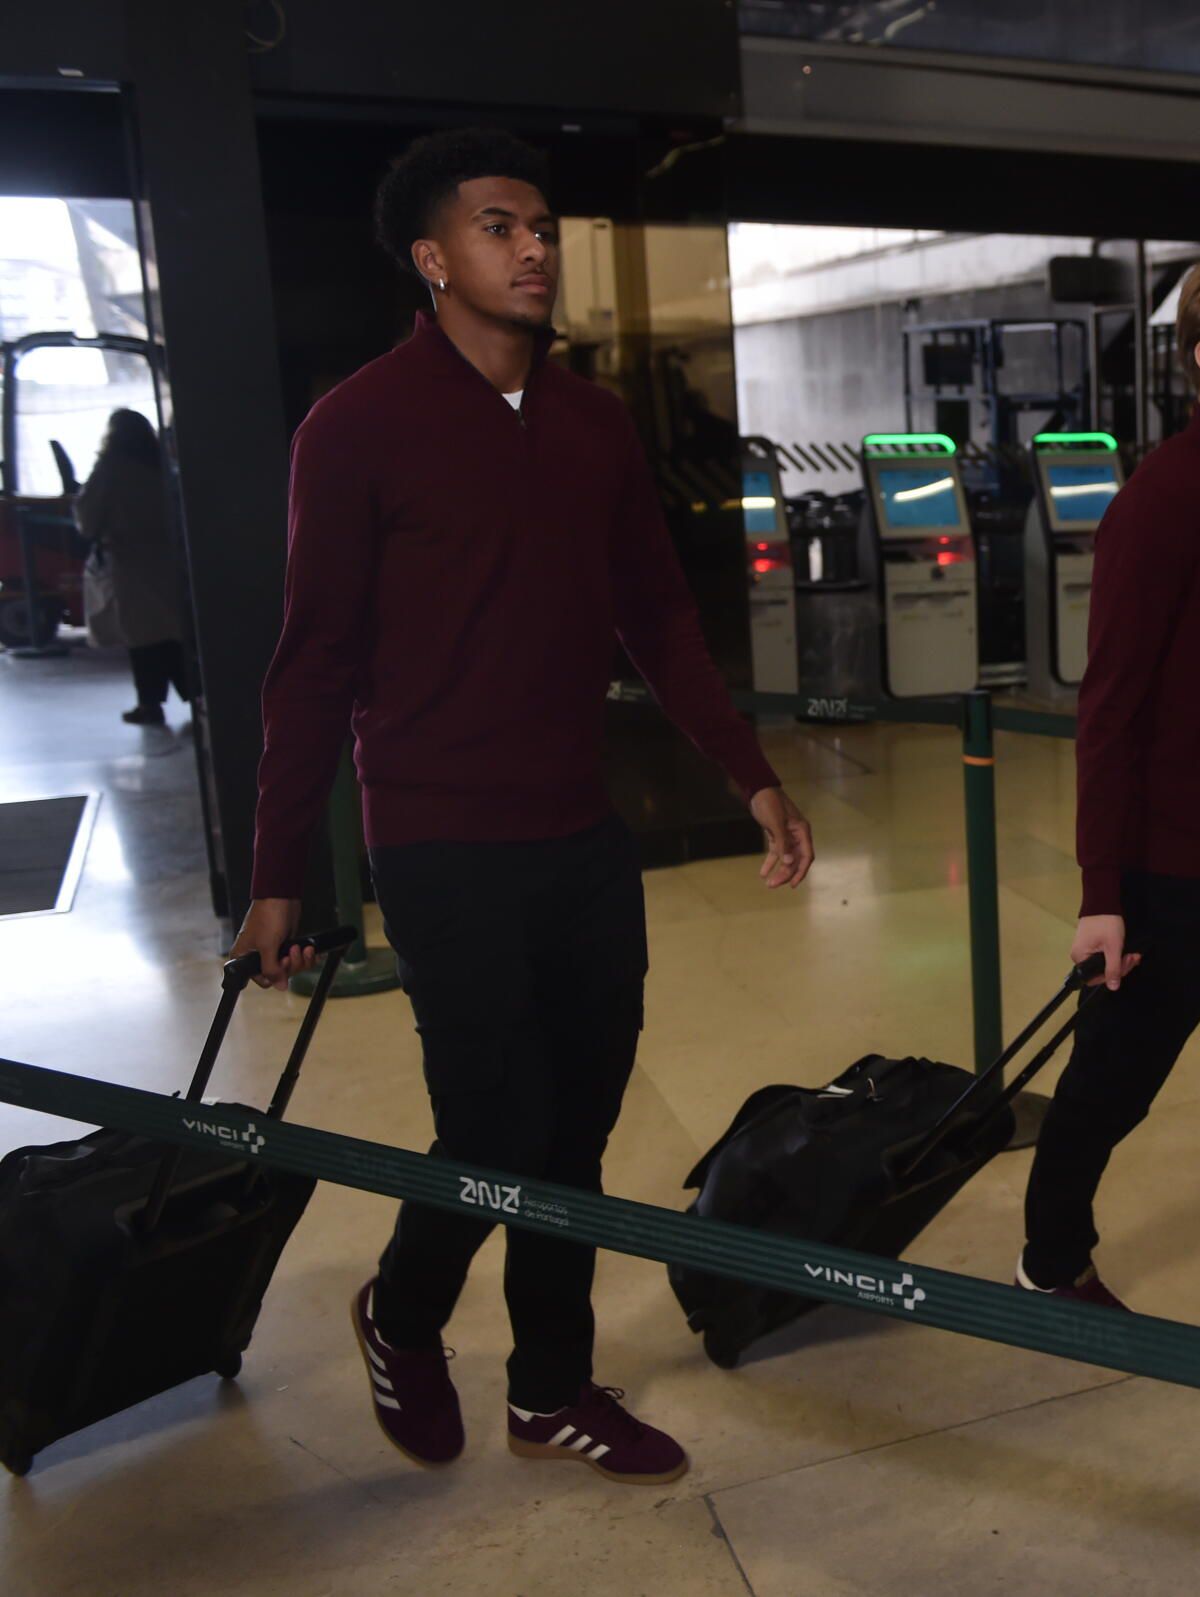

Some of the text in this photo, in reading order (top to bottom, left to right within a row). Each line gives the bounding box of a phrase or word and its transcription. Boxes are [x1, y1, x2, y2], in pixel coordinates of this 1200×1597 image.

[182, 1118, 239, 1141] VINCI
[803, 1263, 885, 1294] VINCI
[857, 1291, 894, 1307] AIRPORTS
